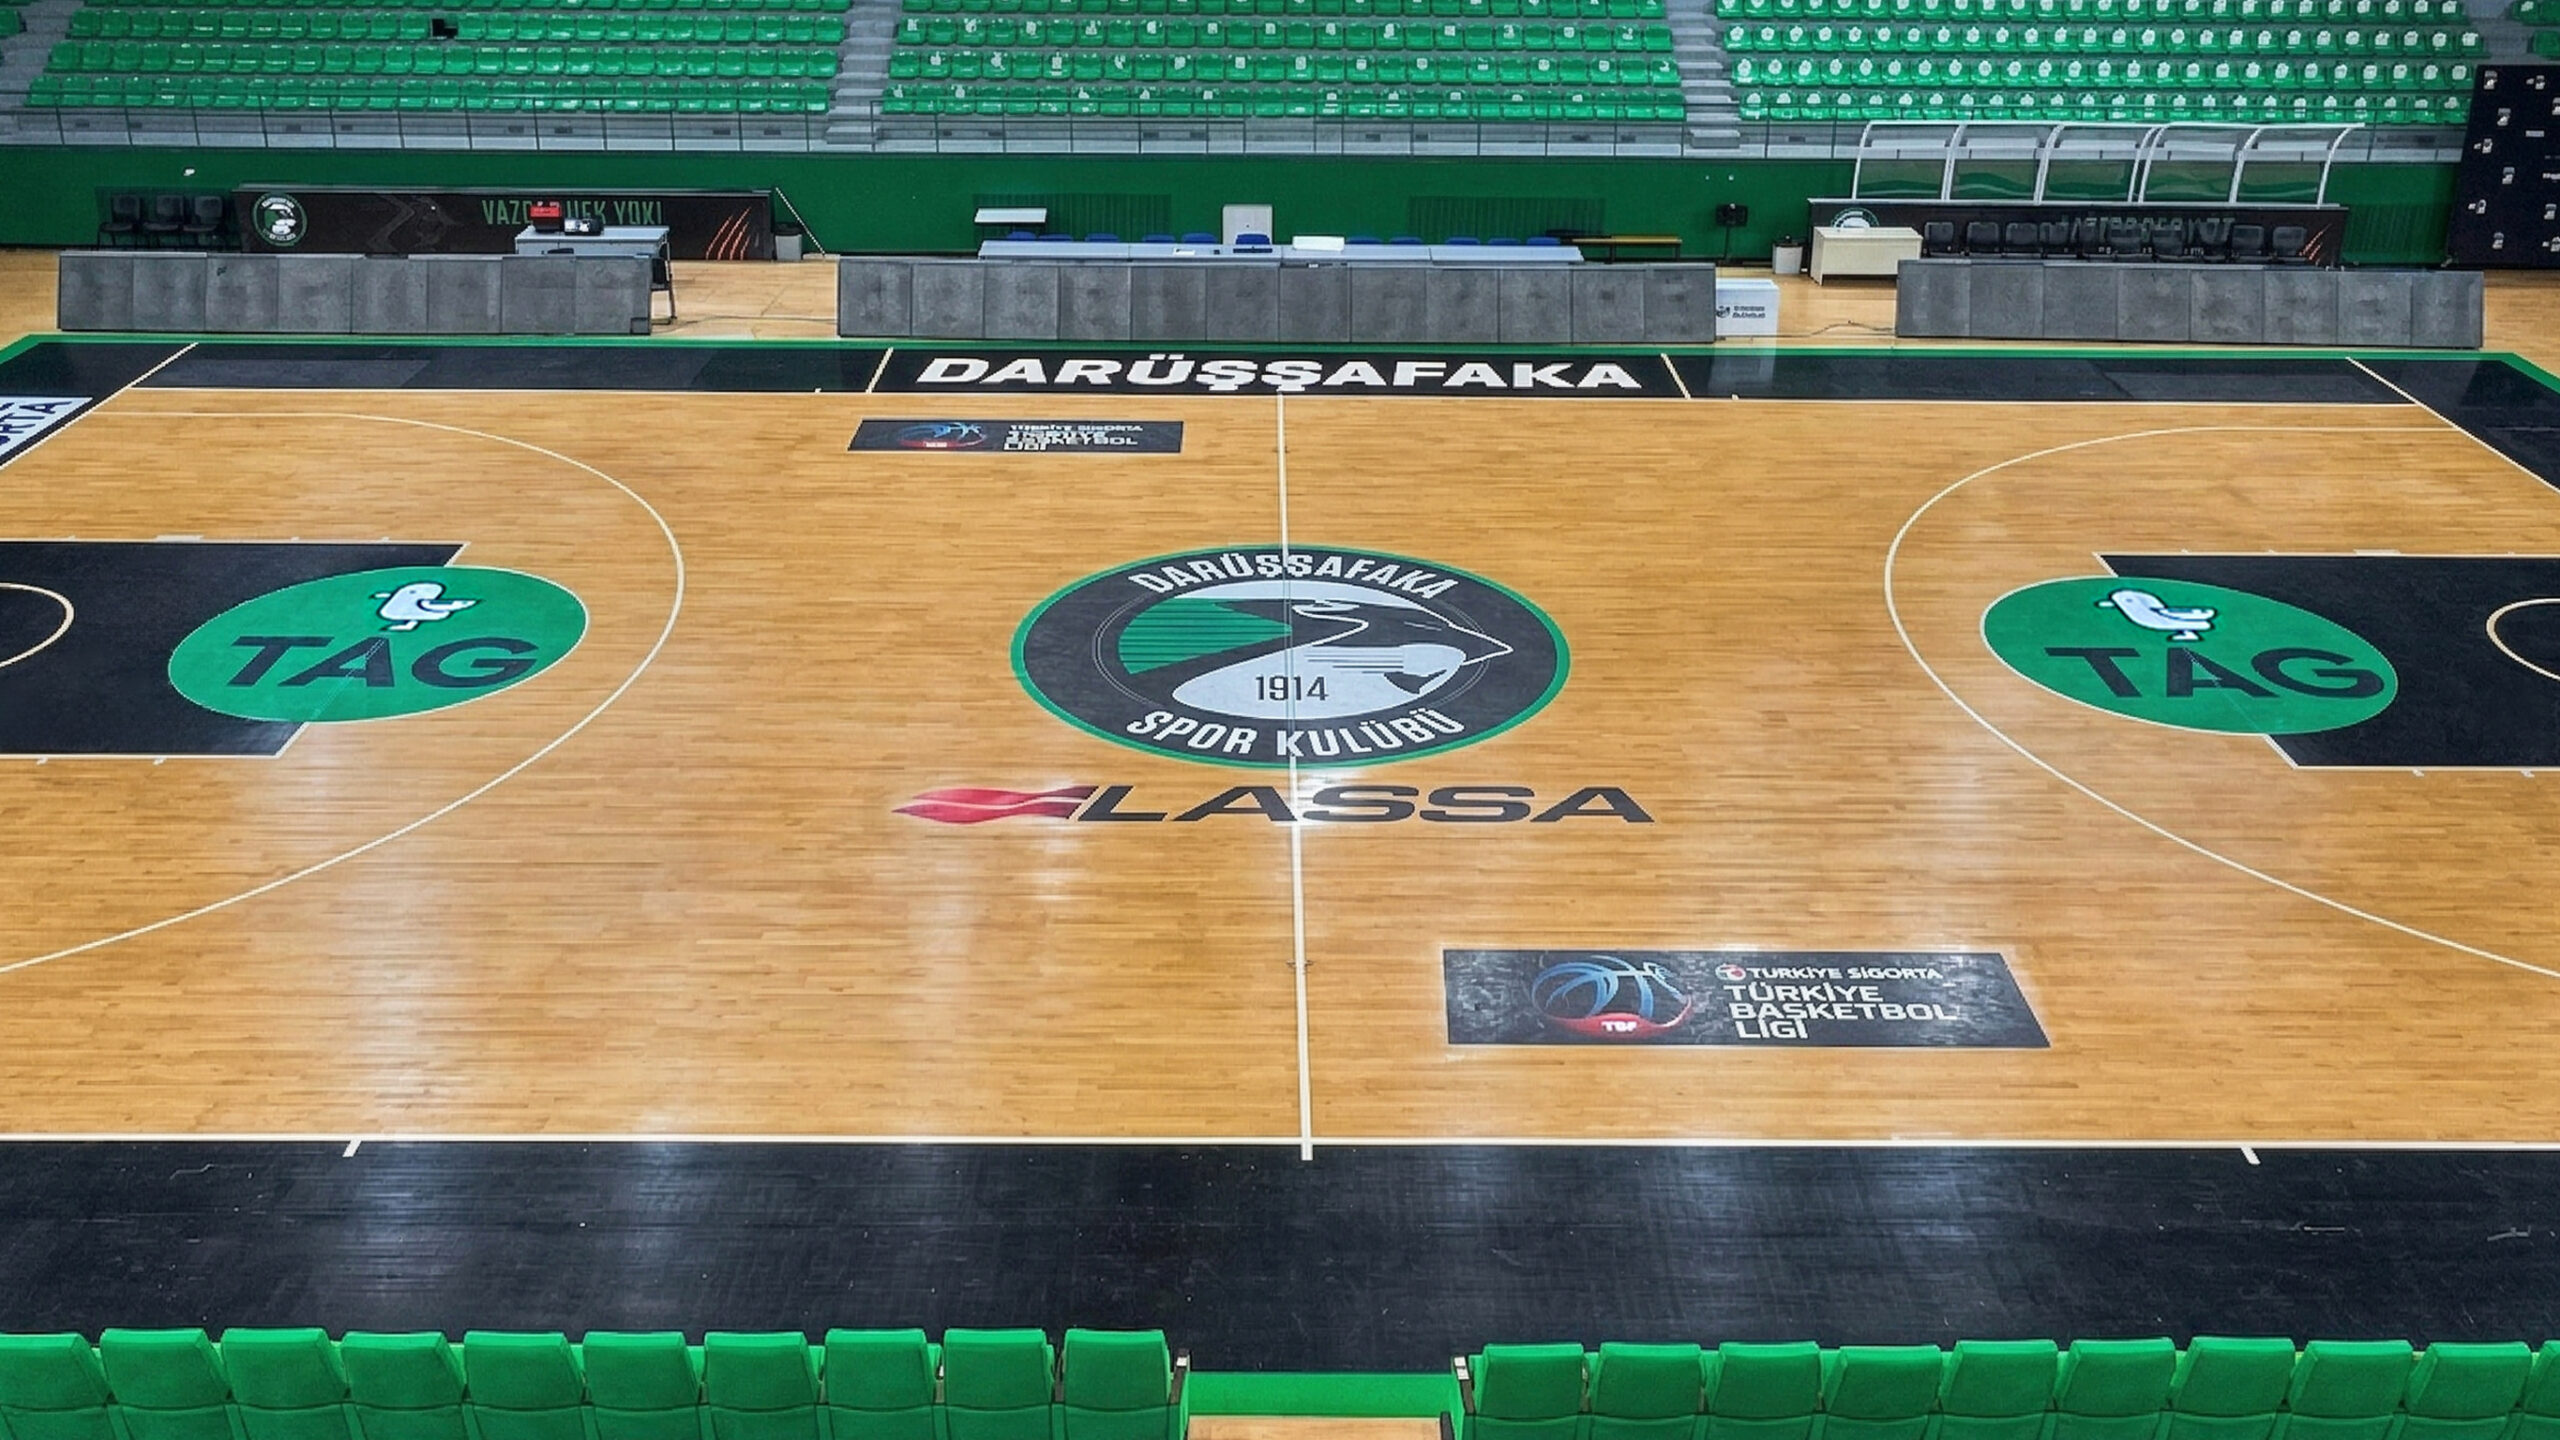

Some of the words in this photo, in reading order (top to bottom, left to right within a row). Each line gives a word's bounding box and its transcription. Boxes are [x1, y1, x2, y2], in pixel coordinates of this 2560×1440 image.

[917, 353, 1642, 392] DARÜŞŞAFAKA
[1128, 553, 1460, 600] DARÜŞŞAFAKA
[226, 636, 540, 689] TAG
[2044, 647, 2385, 699] TAG
[1255, 676, 1329, 701] 1914
[1126, 711, 1258, 756] SPOR
[1276, 708, 1465, 757] KULÜBÜ
[1078, 786, 1655, 822] LASSA
[1723, 982, 1884, 1002] TÜRKİYE
[1728, 1003, 1958, 1020] BASKETBOL
